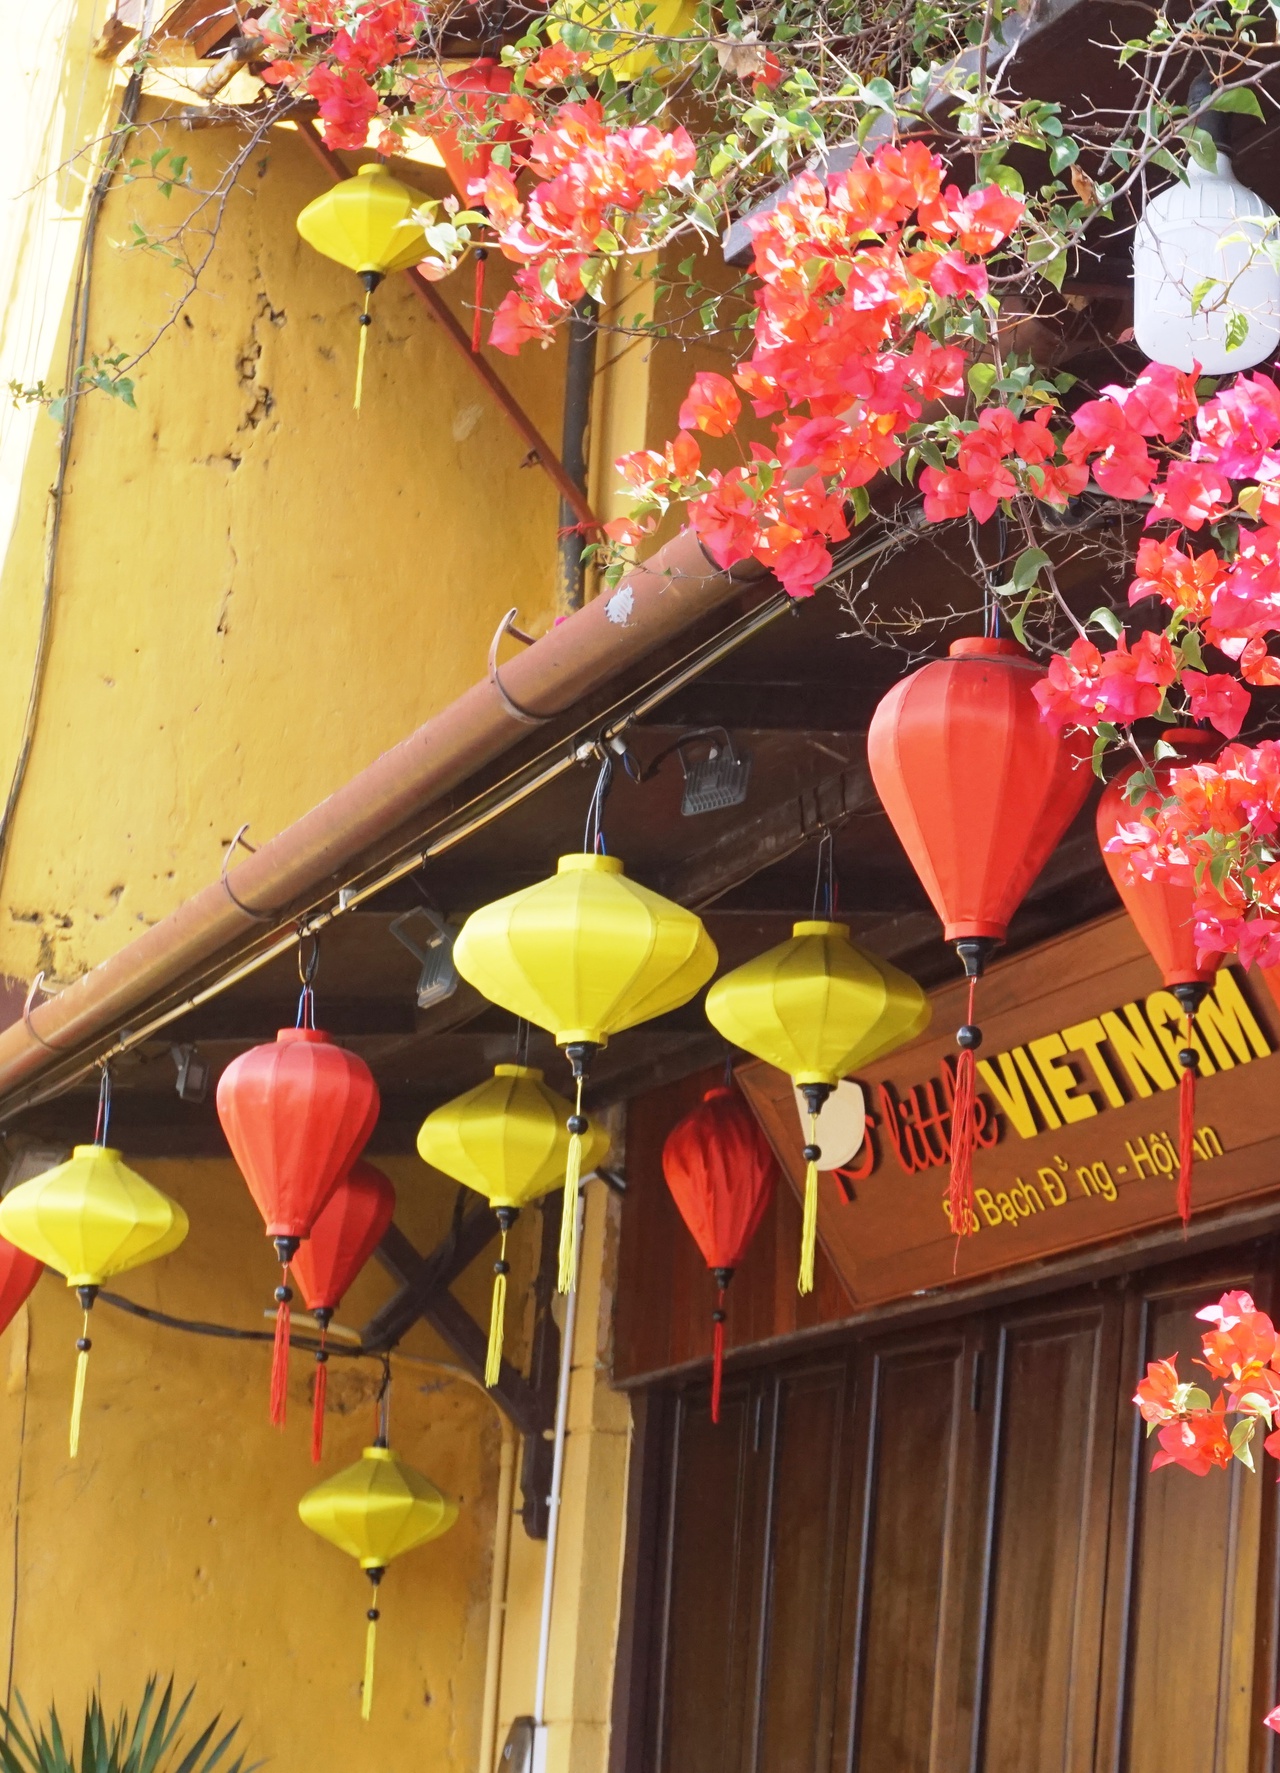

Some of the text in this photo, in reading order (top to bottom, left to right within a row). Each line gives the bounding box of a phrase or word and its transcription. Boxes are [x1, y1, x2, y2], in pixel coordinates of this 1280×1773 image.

[976, 967, 1272, 1140] VIETNAM
[974, 1177, 1045, 1227] Bạch
[1125, 1131, 1181, 1180] Hội
